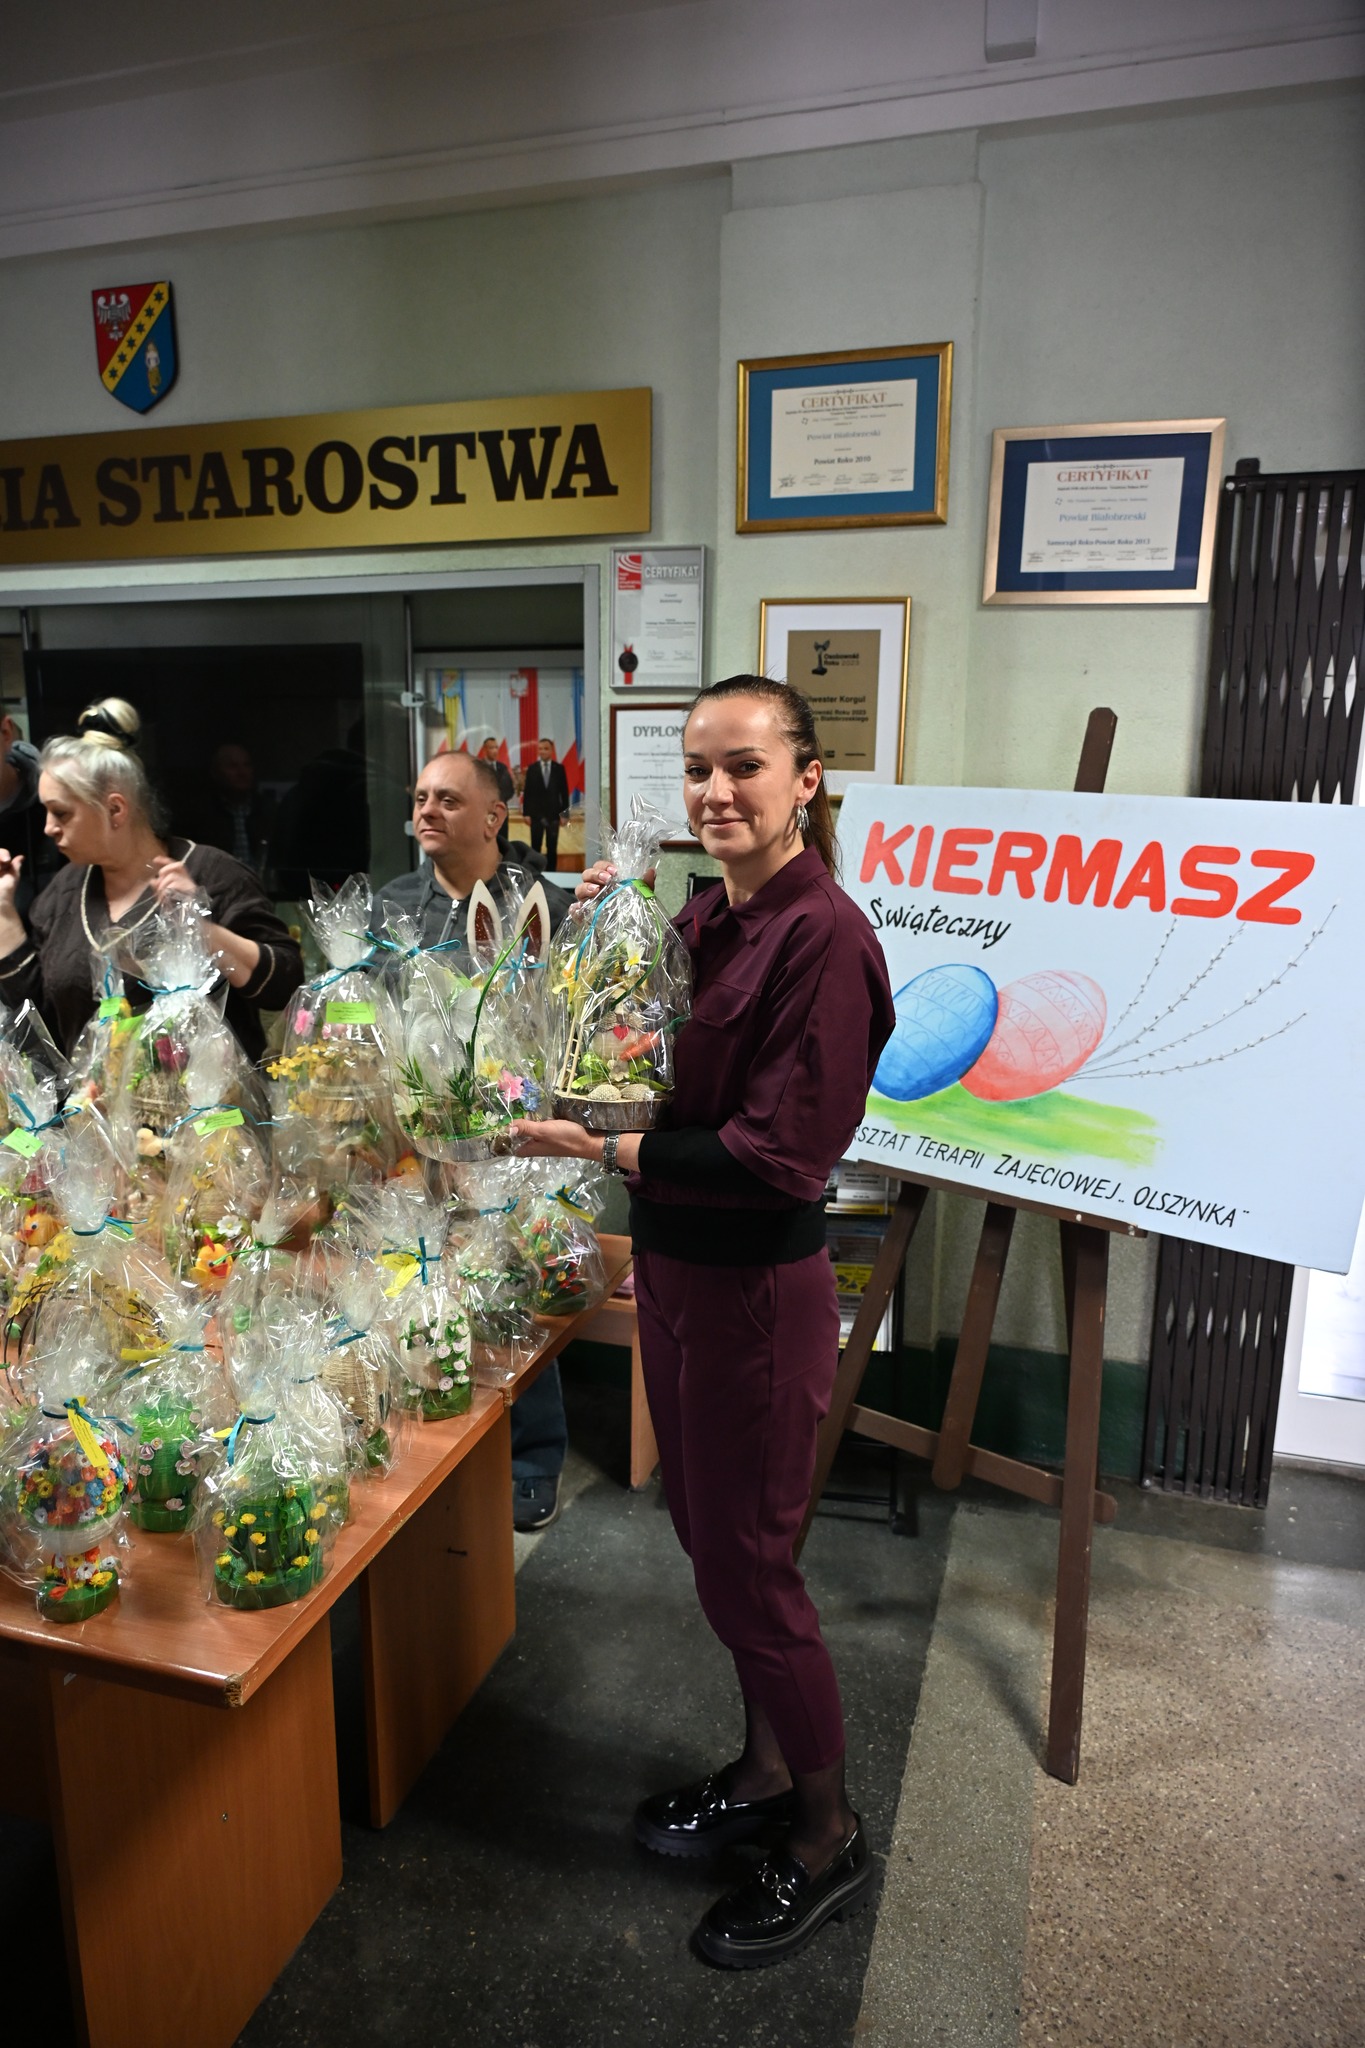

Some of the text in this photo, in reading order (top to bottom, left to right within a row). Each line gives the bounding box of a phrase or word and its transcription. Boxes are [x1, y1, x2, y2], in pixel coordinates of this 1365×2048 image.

[801, 392, 888, 409] CERTYFIKAT
[814, 457, 835, 465] Powiat
[837, 456, 853, 464] Roku
[95, 423, 619, 526] STAROSTWA
[1057, 469, 1152, 483] CERTYFIKAT
[1059, 513, 1088, 522] Powiat
[644, 565, 699, 578] CERTYFIKAT
[633, 725, 684, 737] DYPLOM
[859, 821, 1316, 925] KIERMASZ
[868, 897, 1012, 949] Świąteczny
[915, 1136, 985, 1169] TERAPII
